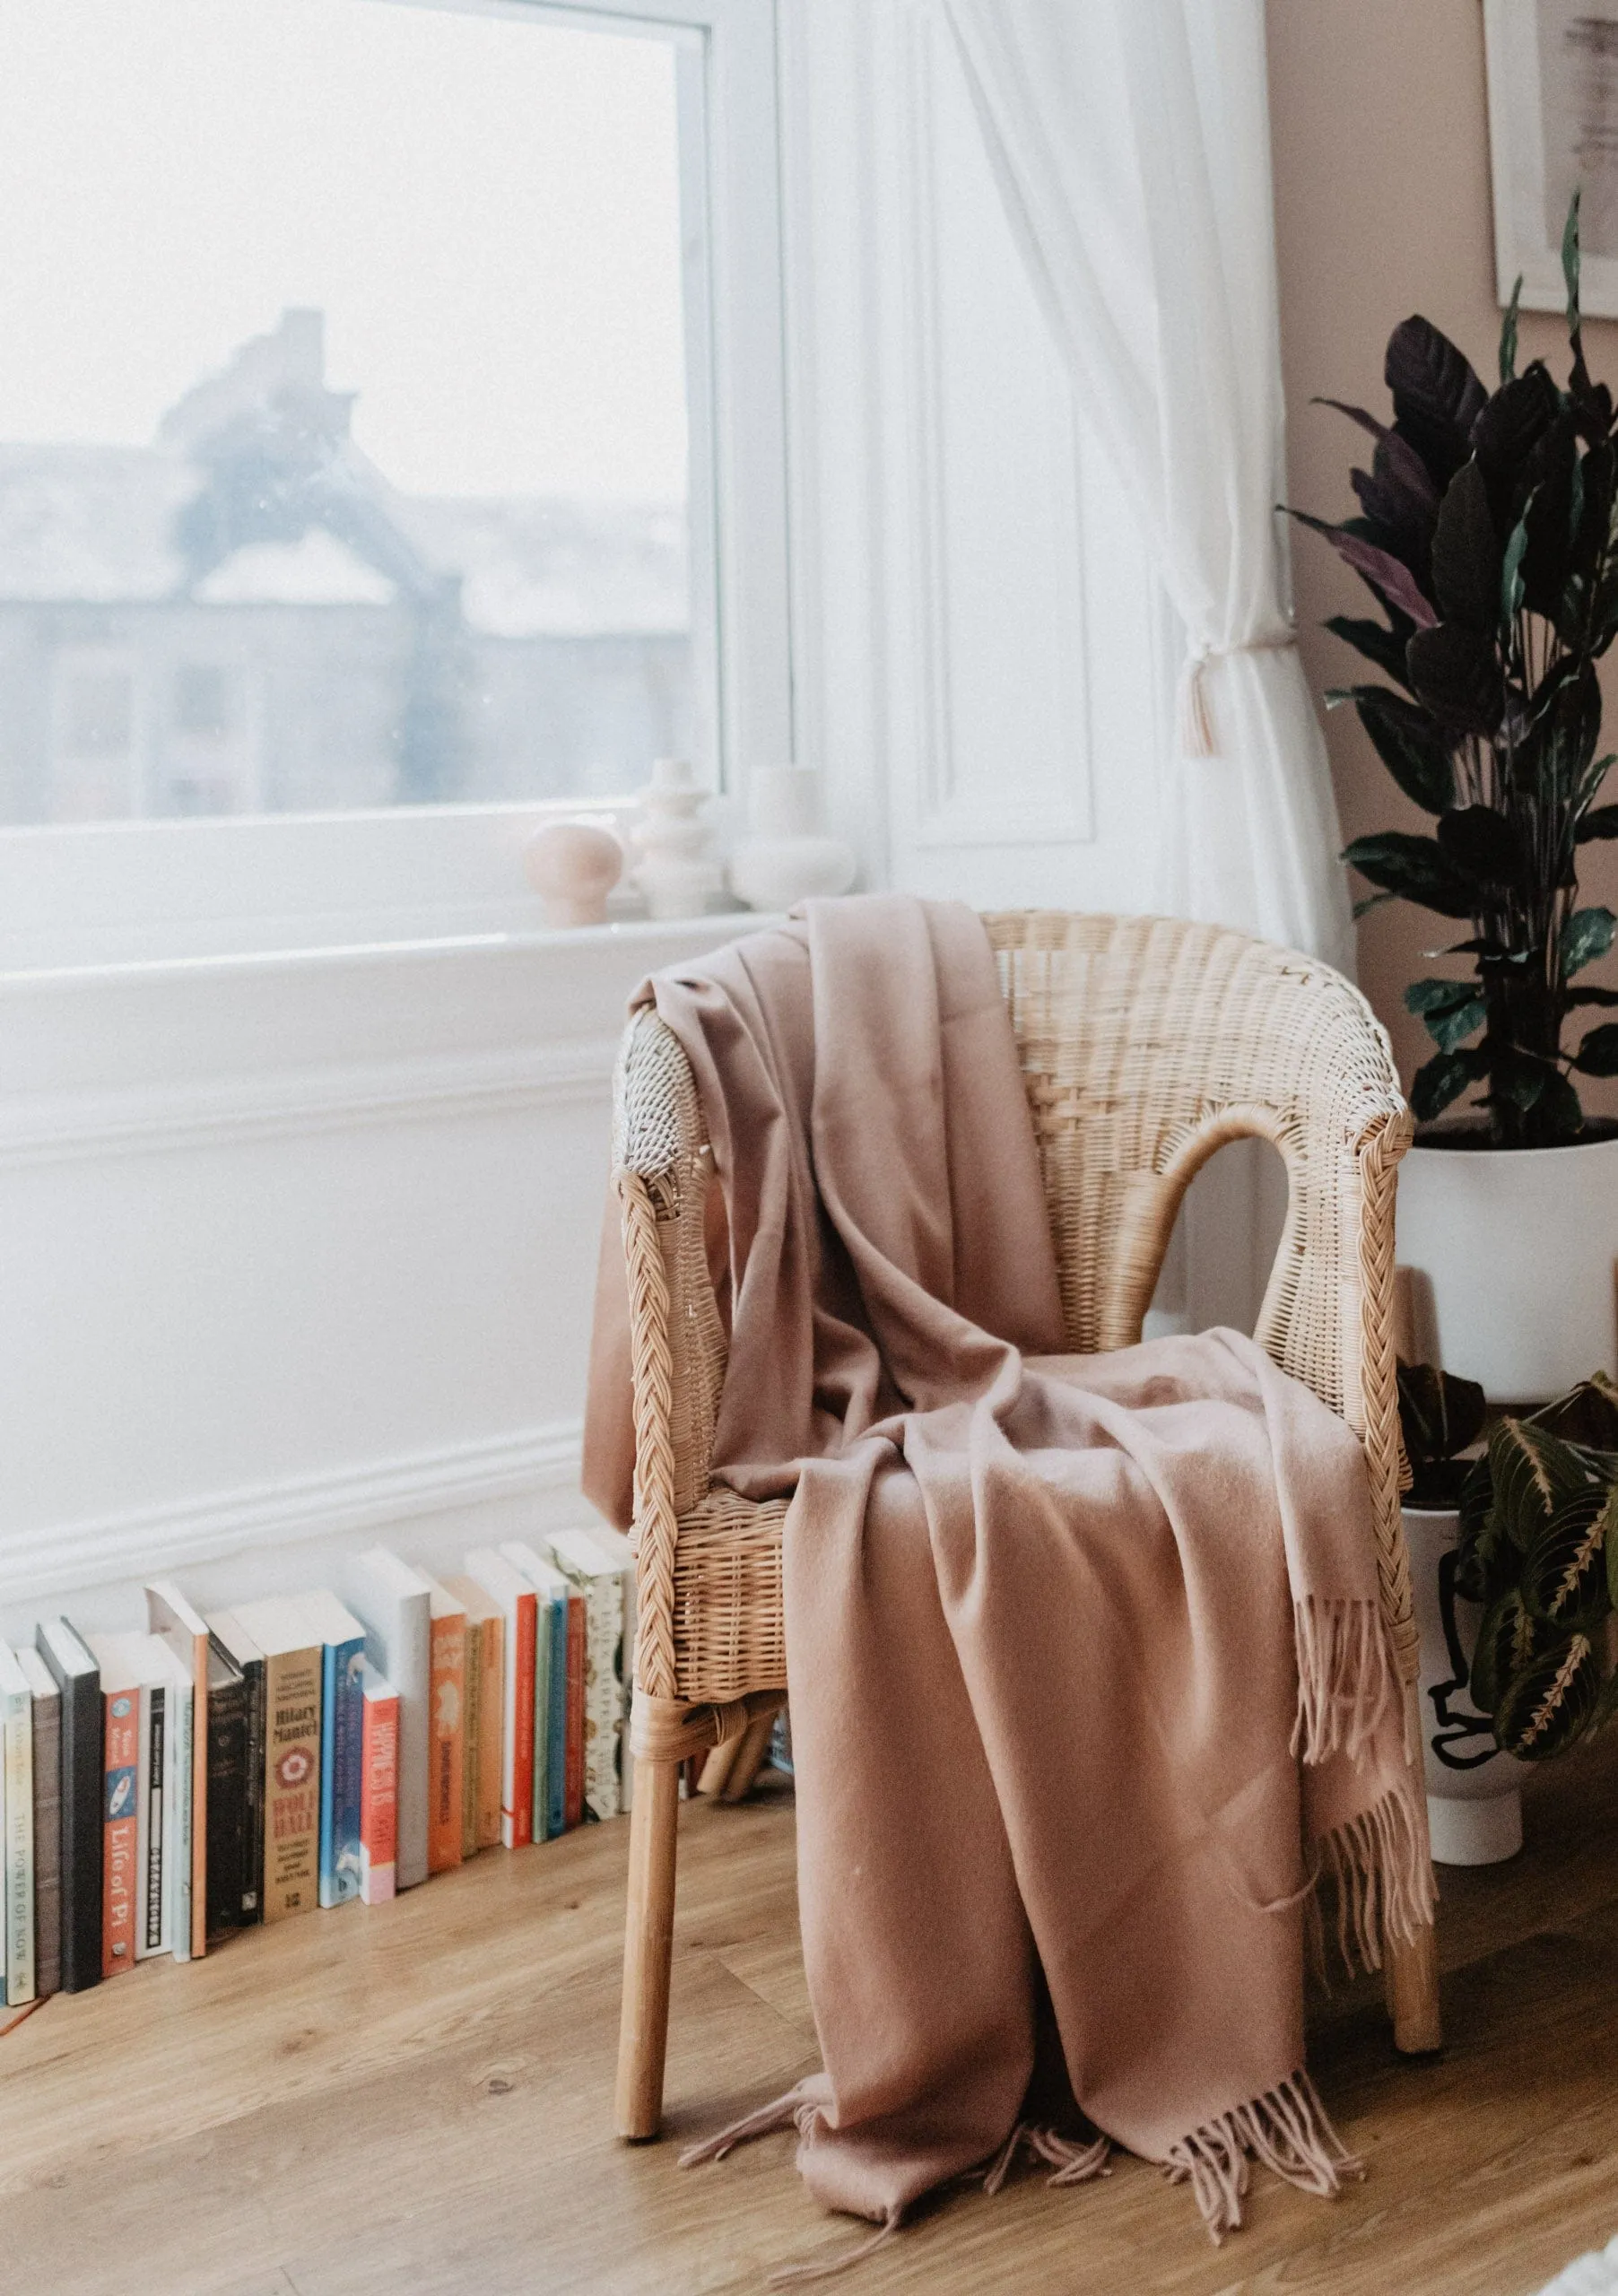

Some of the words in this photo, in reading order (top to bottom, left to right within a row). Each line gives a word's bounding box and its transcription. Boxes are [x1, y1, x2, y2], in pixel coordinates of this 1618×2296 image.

[275, 1706, 316, 1726] Hilary
[13, 1813, 26, 1841] THE
[111, 1825, 130, 1874] Life
[13, 1848, 27, 1900] POWER
[111, 1875, 127, 1895] of
[14, 1903, 27, 1922] OF
[111, 1902, 128, 1927] Pi
[14, 1928, 27, 1961] NOW
